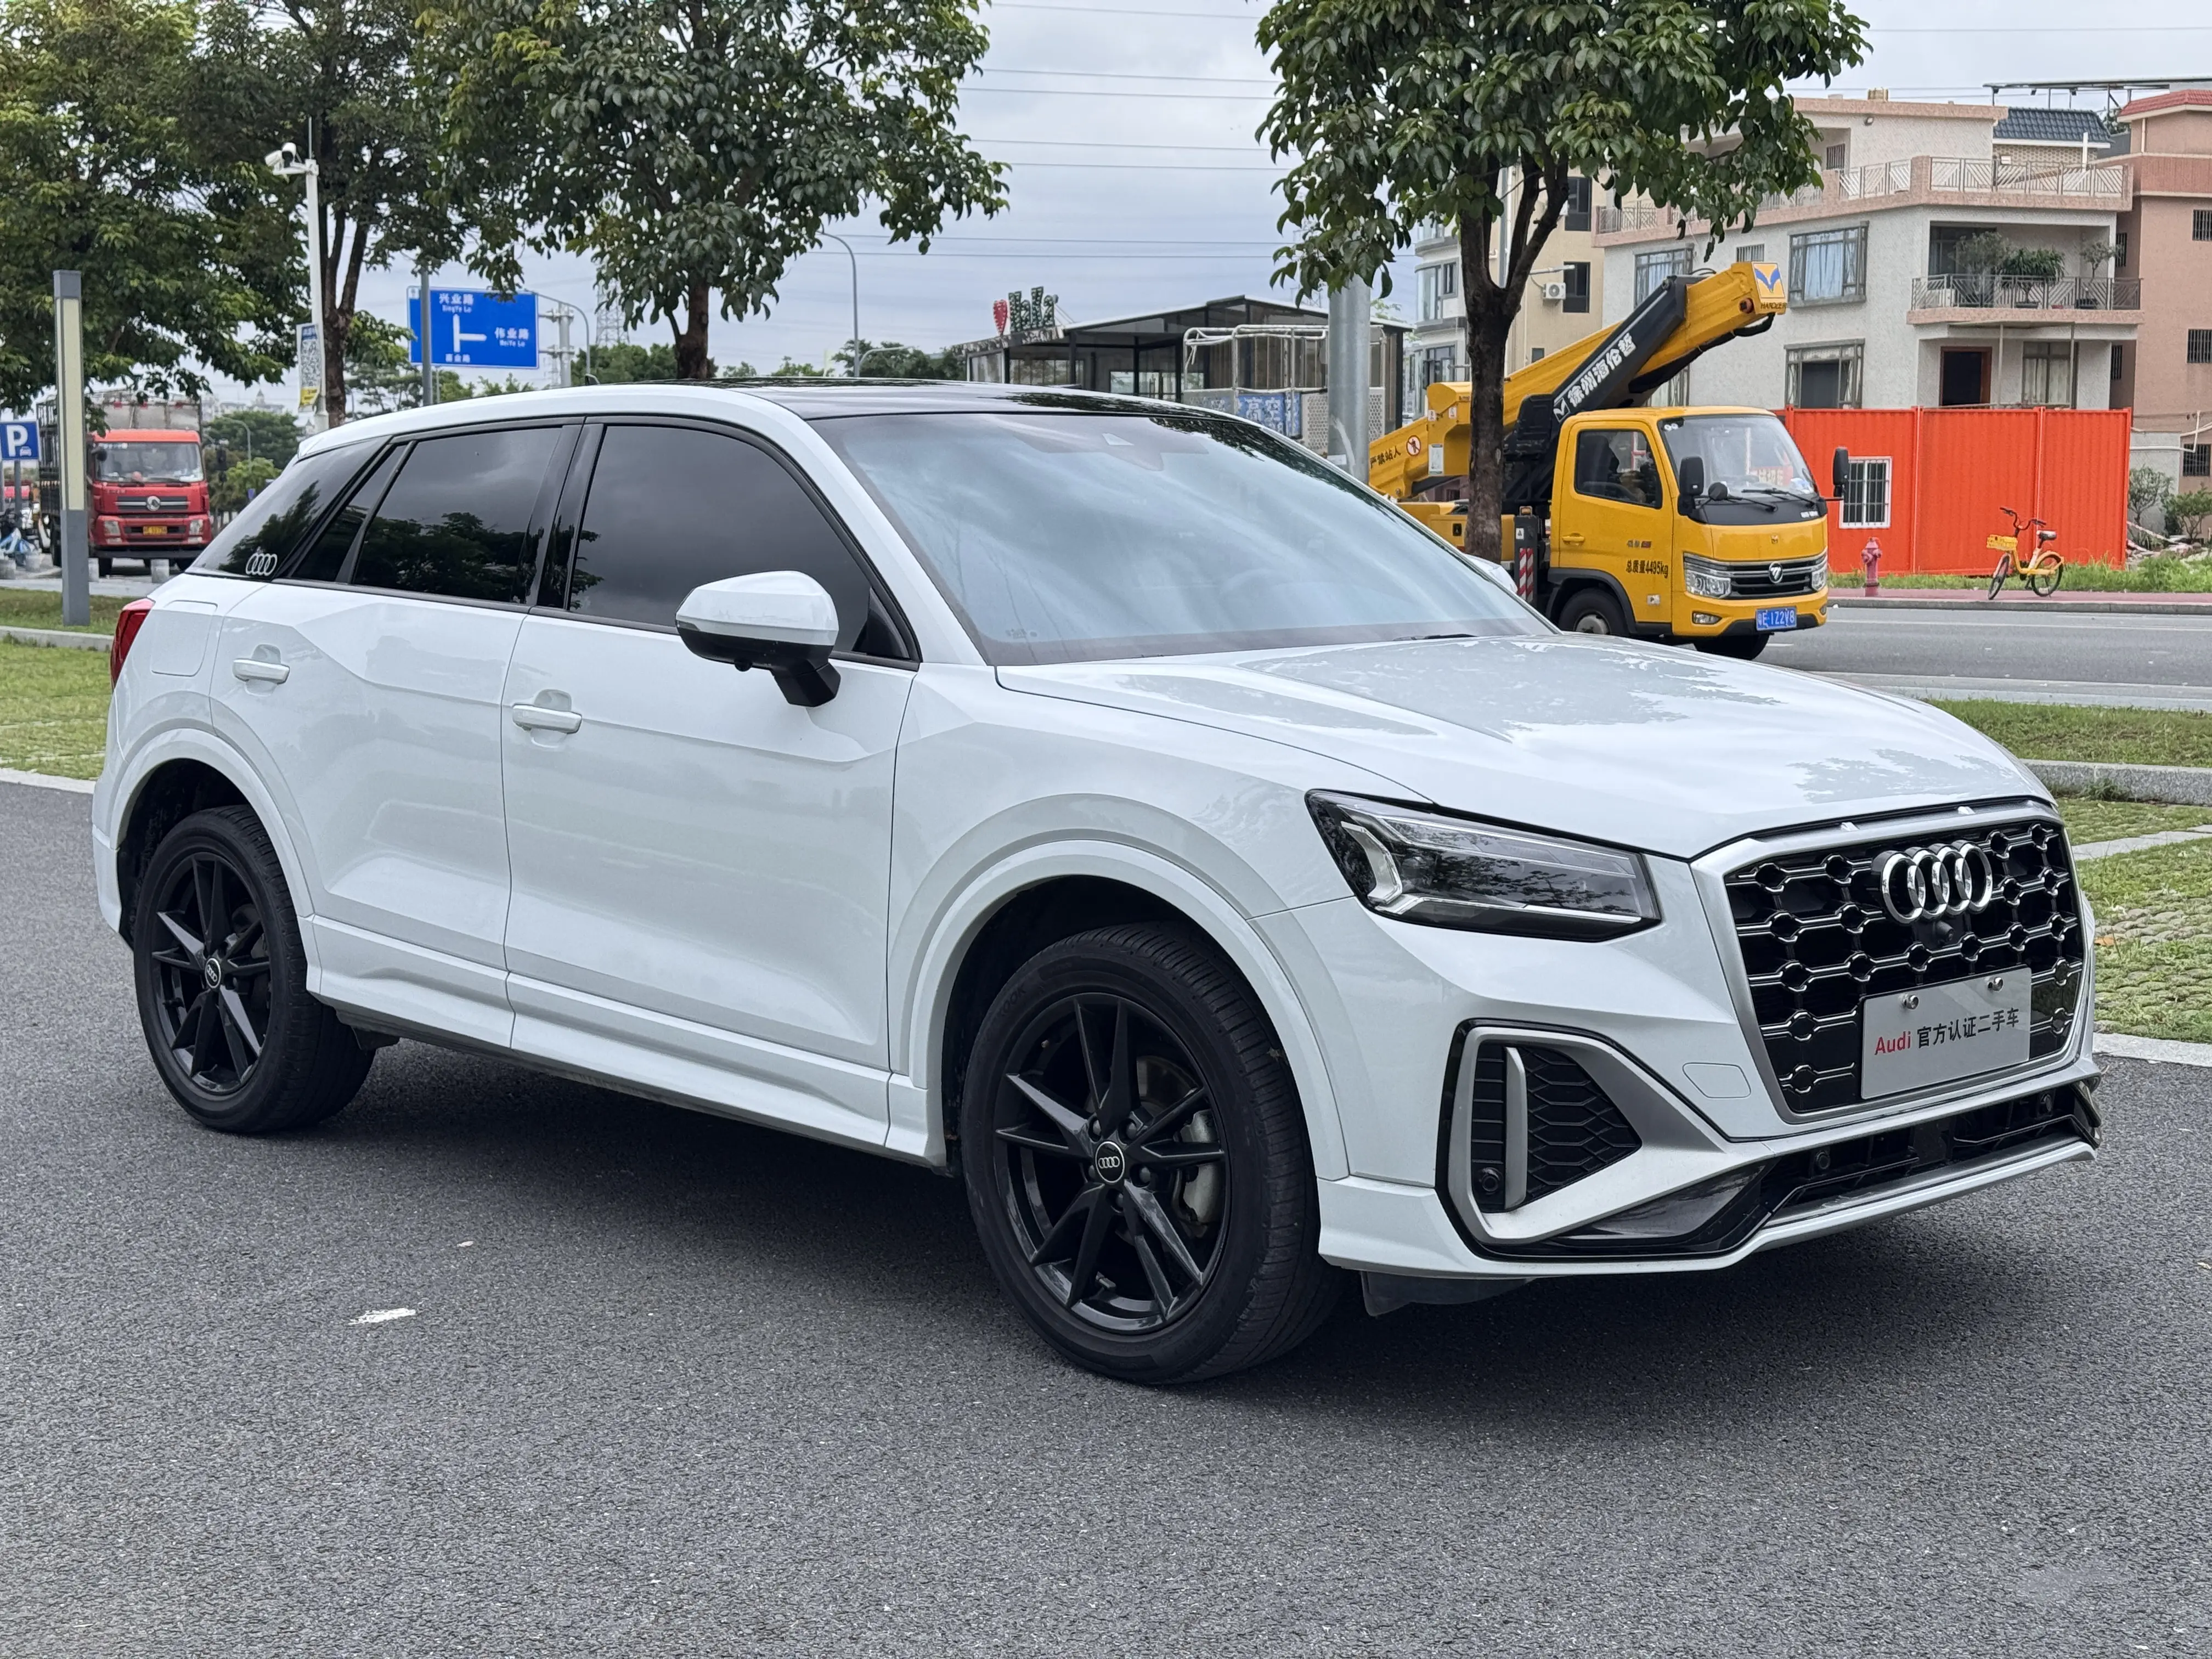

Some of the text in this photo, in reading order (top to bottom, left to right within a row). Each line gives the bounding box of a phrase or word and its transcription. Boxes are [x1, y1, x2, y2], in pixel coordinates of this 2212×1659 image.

[1567, 332, 1636, 407] 徐州海伦哲
[6, 425, 28, 457] P
[1369, 445, 1401, 469] 严禁站人
[1874, 1007, 2019, 1056] Audi 官方认证二手车
